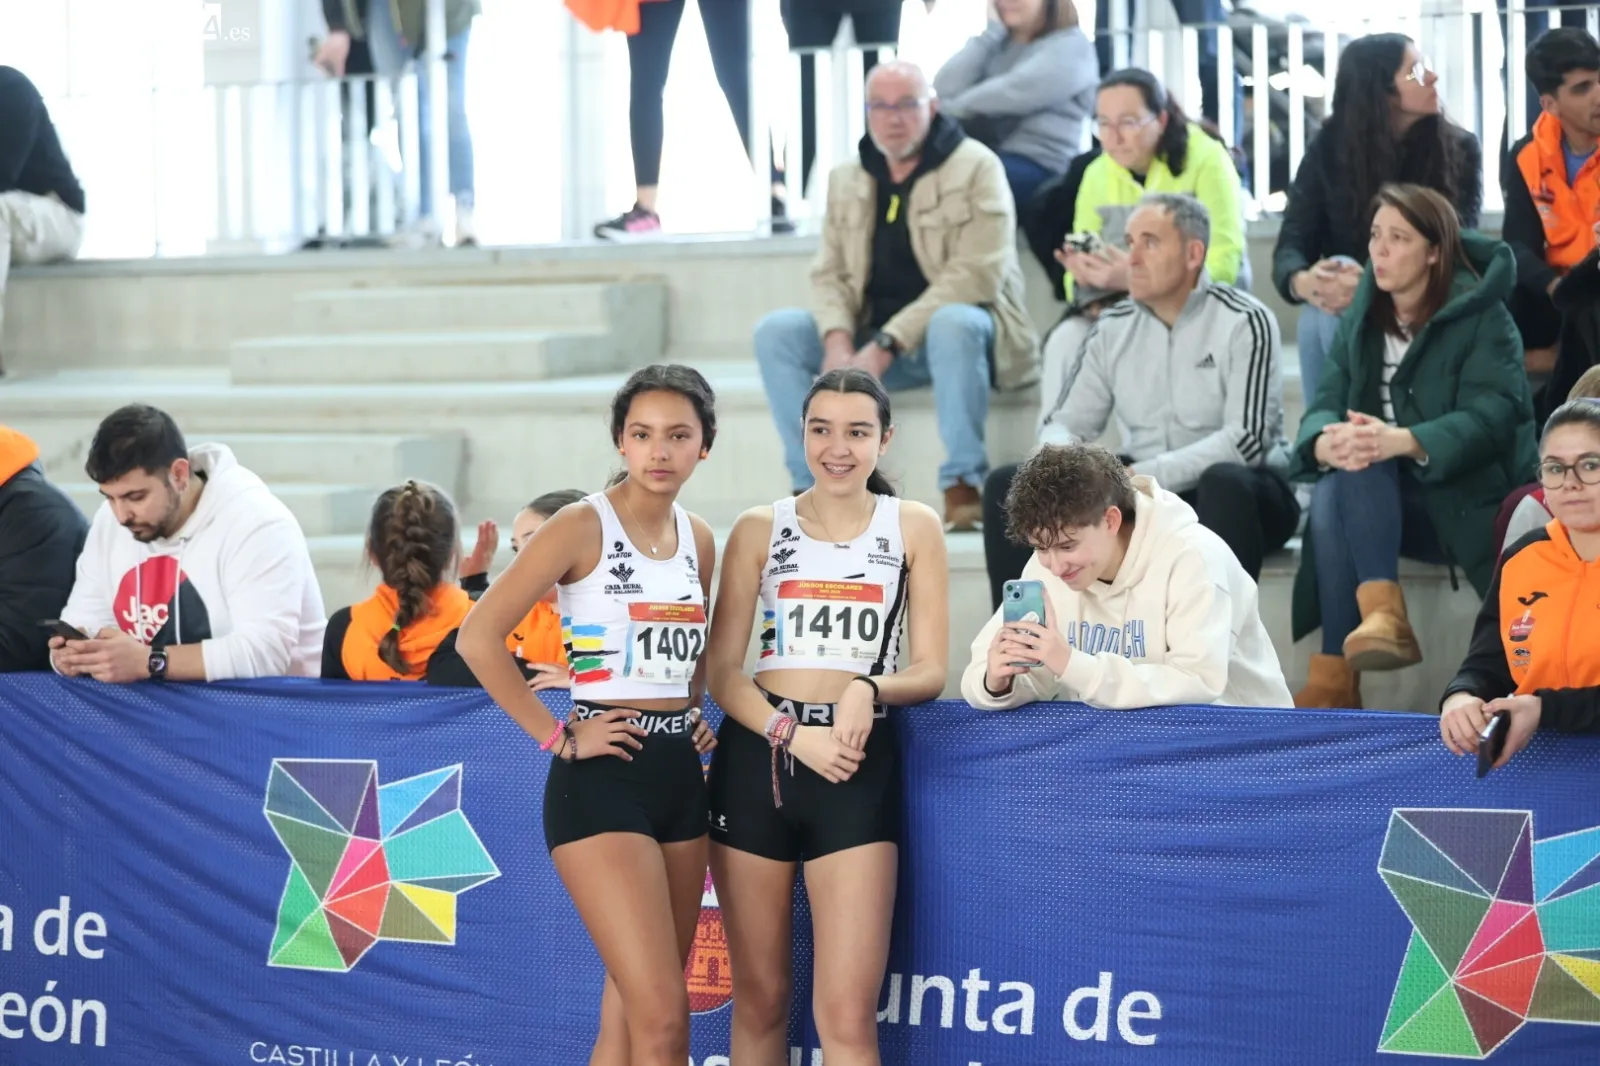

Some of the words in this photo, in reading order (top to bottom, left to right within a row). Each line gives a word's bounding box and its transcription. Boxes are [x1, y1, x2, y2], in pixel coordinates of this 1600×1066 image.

[636, 626, 702, 662] 1402
[788, 603, 880, 642] 1410
[33, 895, 108, 960] de
[876, 967, 1036, 1036] unta
[1062, 971, 1163, 1046] de
